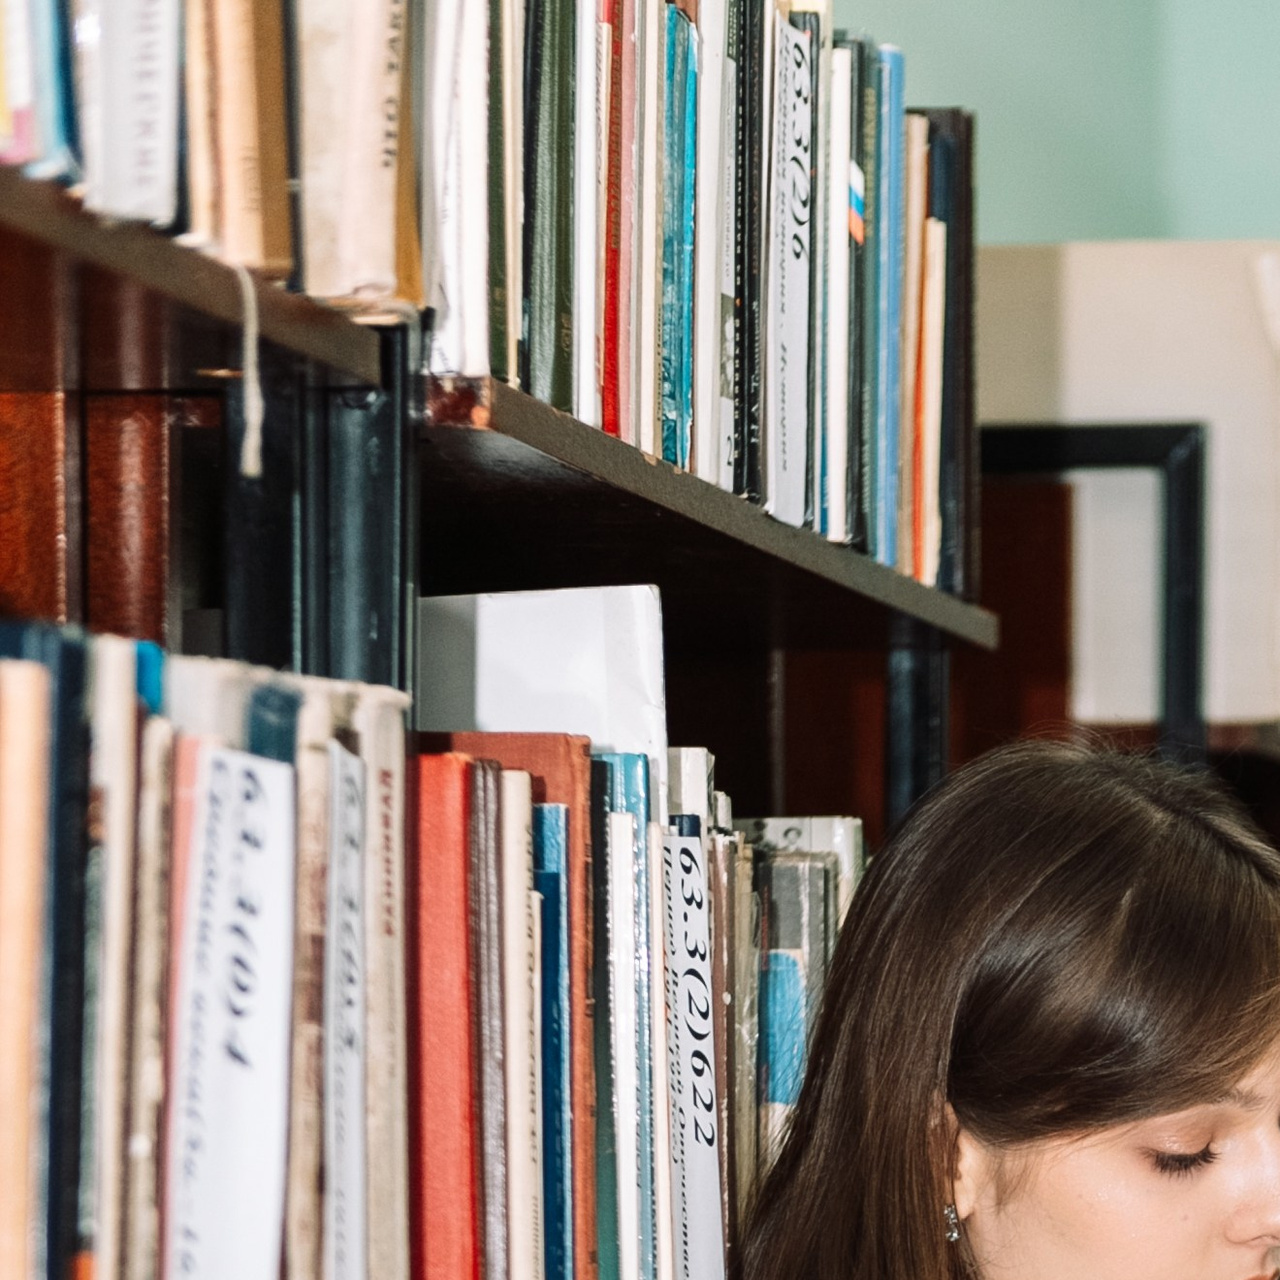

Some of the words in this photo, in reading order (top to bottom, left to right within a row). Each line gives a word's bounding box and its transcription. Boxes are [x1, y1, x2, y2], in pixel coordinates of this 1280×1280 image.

[790, 41, 810, 262] 63.3(2)6
[663, 846, 676, 957] Период
[671, 967, 684, 1097] Великой
[679, 846, 715, 1148] 63.3(2)622
